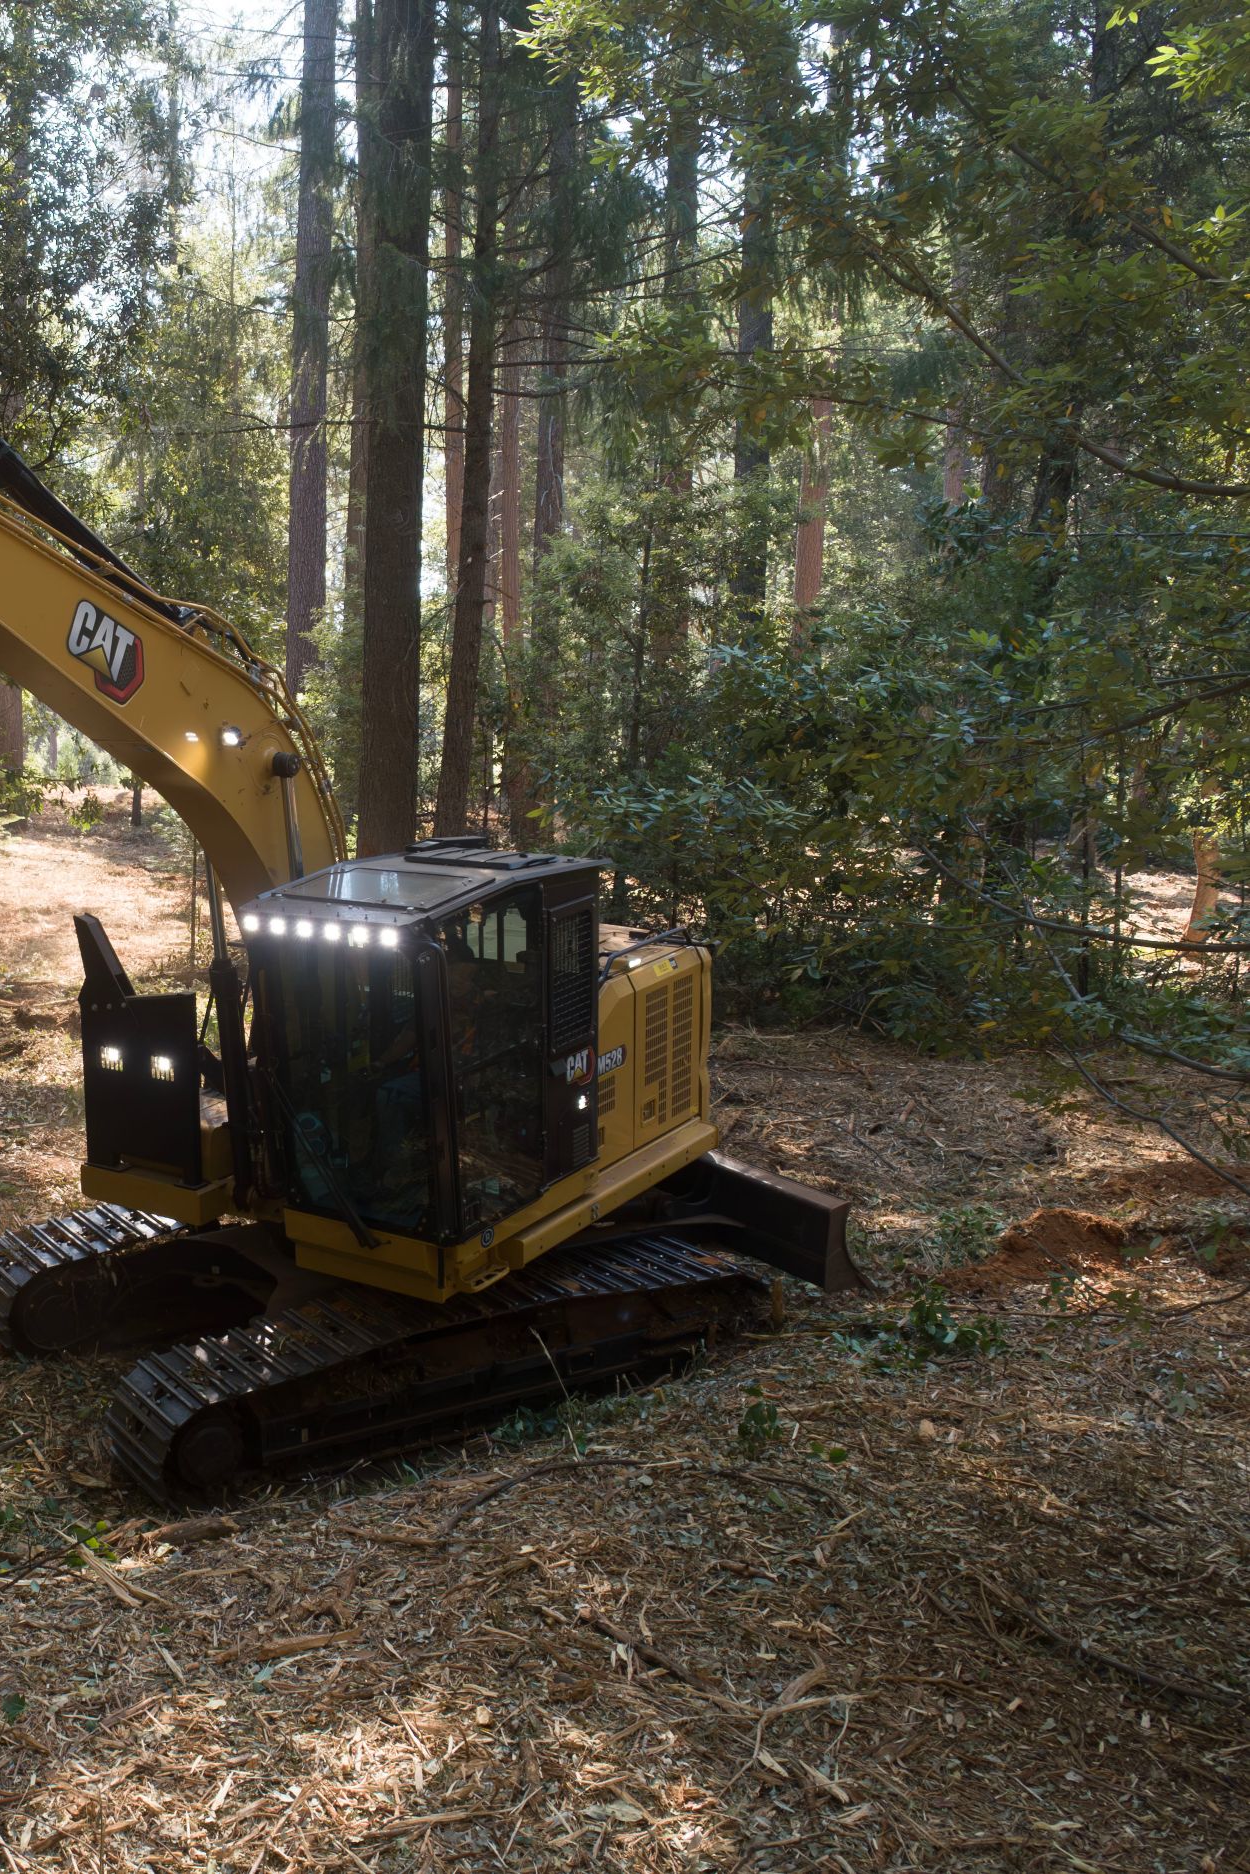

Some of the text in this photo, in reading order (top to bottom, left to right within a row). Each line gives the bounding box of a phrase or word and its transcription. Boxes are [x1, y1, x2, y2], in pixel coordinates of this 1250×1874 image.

[68, 601, 135, 682] CAT
[566, 1049, 589, 1082] CAT
[598, 1047, 623, 1076] M528
